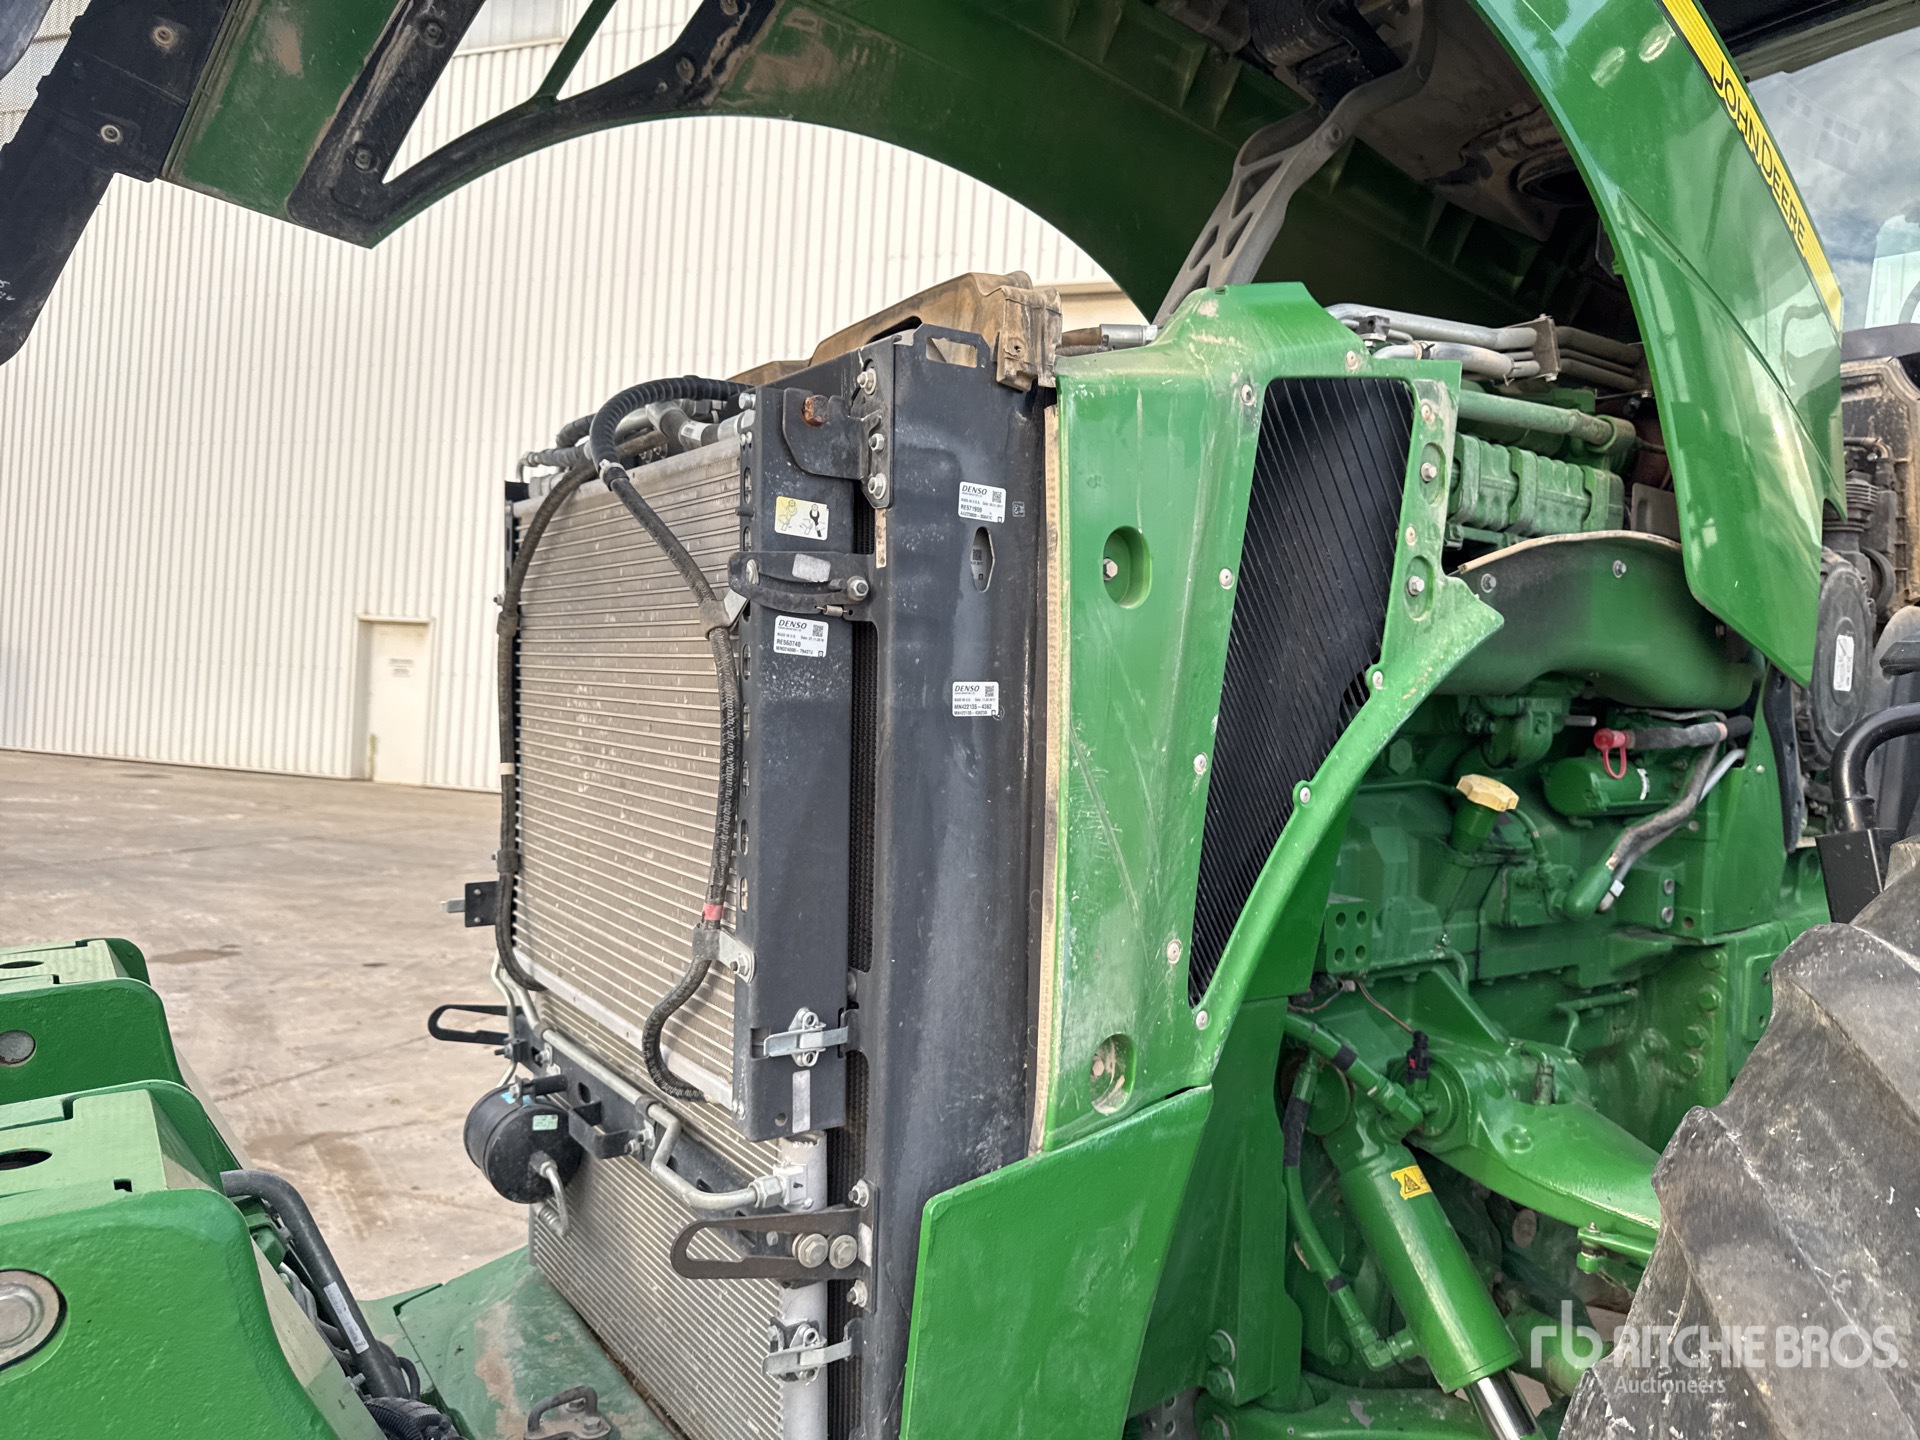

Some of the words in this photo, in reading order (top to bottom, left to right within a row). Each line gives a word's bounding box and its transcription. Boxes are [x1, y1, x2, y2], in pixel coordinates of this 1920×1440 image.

[1713, 60, 1760, 158] JOHN
[1761, 135, 1806, 251] DEERE
[962, 484, 987, 496] DENSO
[778, 619, 807, 630] DENSO
[954, 684, 980, 692] DENSO
